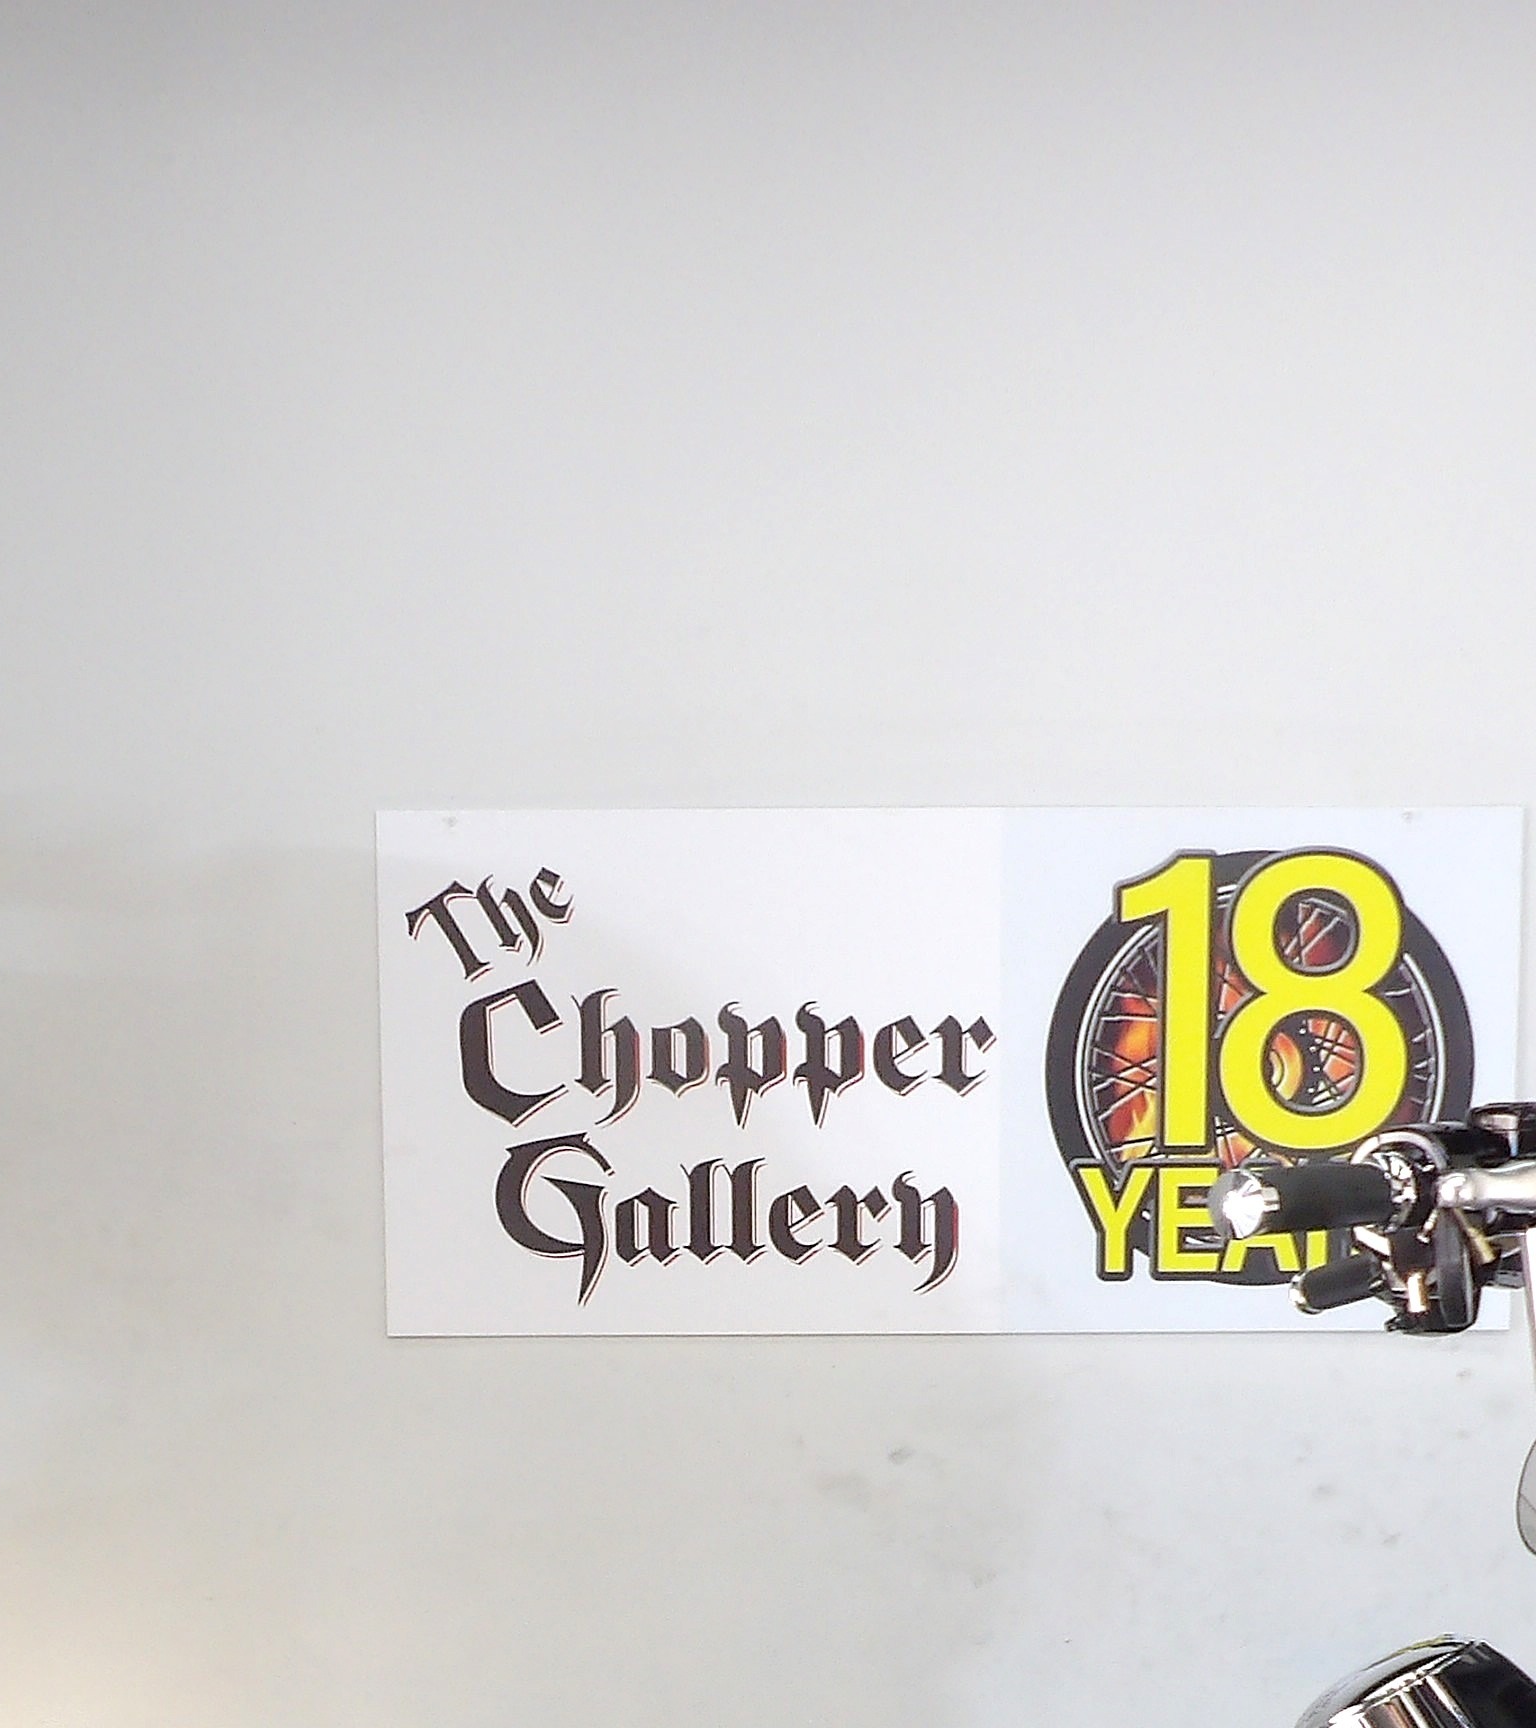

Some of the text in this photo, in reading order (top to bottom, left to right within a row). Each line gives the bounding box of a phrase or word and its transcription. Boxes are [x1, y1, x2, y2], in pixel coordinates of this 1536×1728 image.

[404, 866, 574, 981] The
[1116, 852, 1411, 1150] 18
[458, 977, 997, 1128] Chopper
[495, 1130, 961, 1307] Gallery
